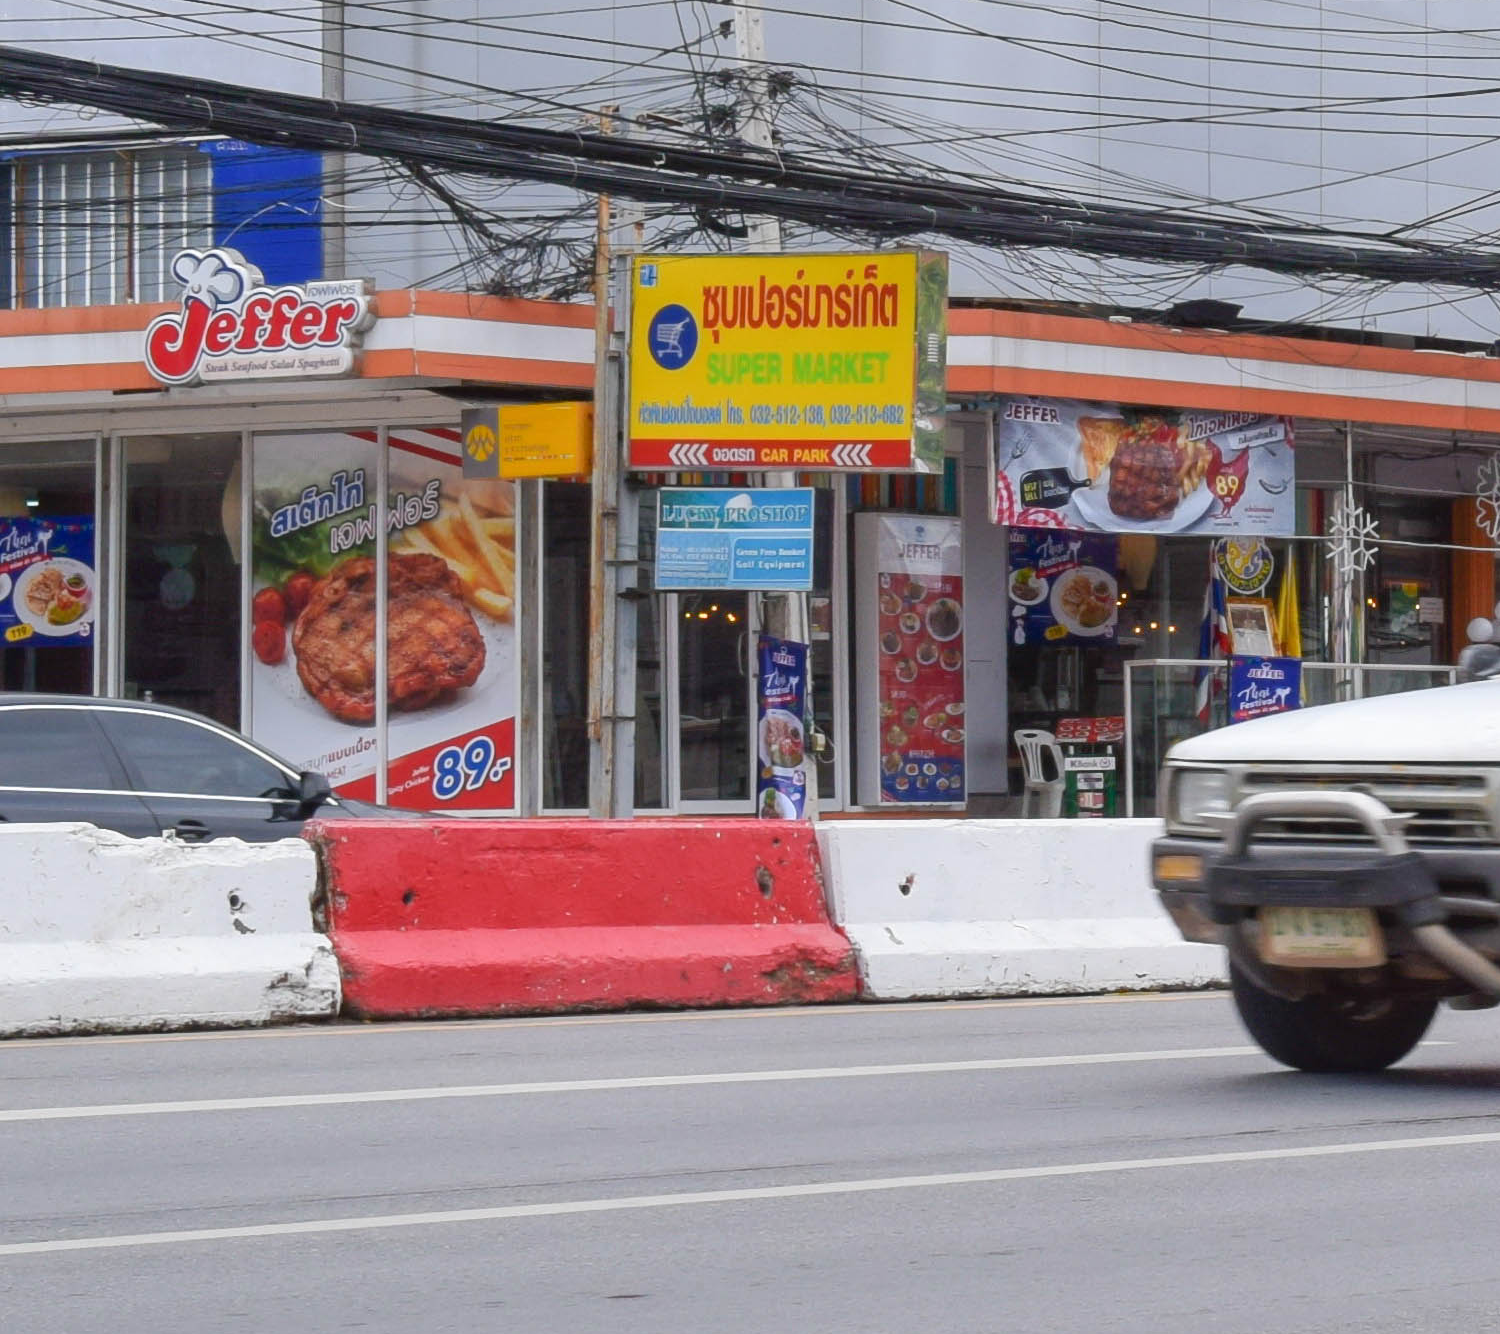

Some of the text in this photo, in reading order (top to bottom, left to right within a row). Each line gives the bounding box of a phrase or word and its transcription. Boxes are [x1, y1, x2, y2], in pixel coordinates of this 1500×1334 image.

[149, 295, 357, 377] Jeffer
[205, 357, 340, 373] Steak Seafood Salad Spaghetti
[706, 351, 890, 385] SUPER MARKET
[1005, 403, 1060, 424] JEFFER
[712, 448, 756, 463] จอดรถ
[760, 448, 829, 463] CAR PARK
[1215, 475, 1239, 496] 89
[270, 468, 365, 538] สเต็กไก่
[662, 504, 810, 524] LUCKY PROSHOP
[898, 543, 943, 560] JEFFER
[1247, 668, 1285, 680] JEFFER
[1239, 695, 1278, 710] Festival
